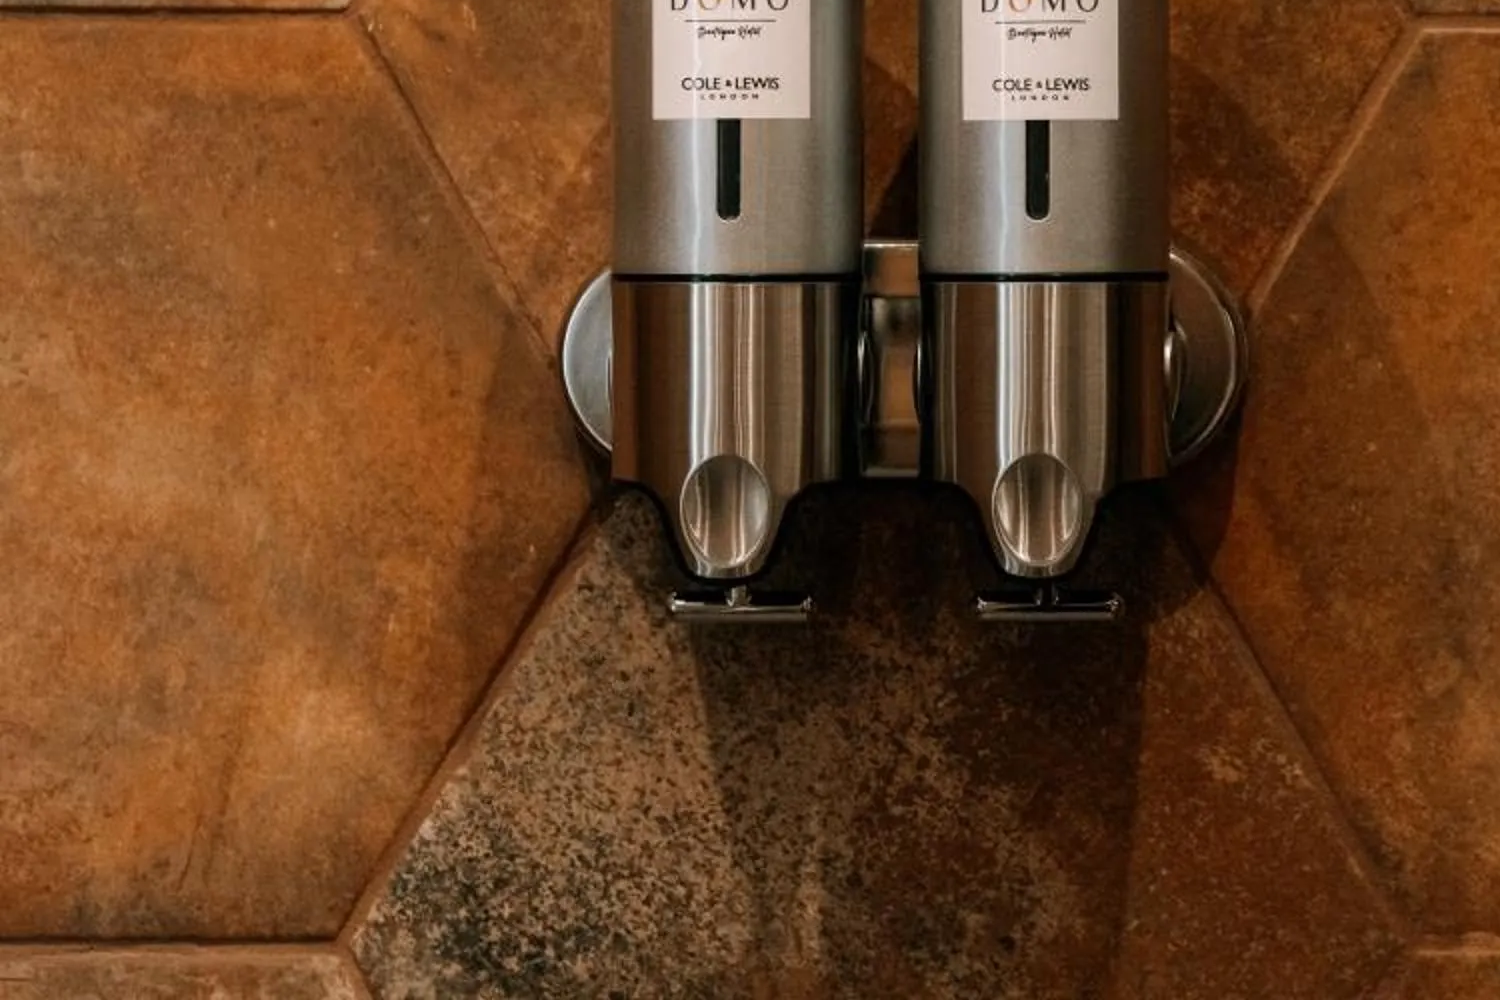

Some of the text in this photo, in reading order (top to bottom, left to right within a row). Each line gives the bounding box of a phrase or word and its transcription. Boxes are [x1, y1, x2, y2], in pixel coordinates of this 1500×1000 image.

[681, 77, 721, 91] COLE
[735, 77, 780, 91] LEWIS
[992, 78, 1031, 92] COLE
[1045, 78, 1091, 92] LEWIS
